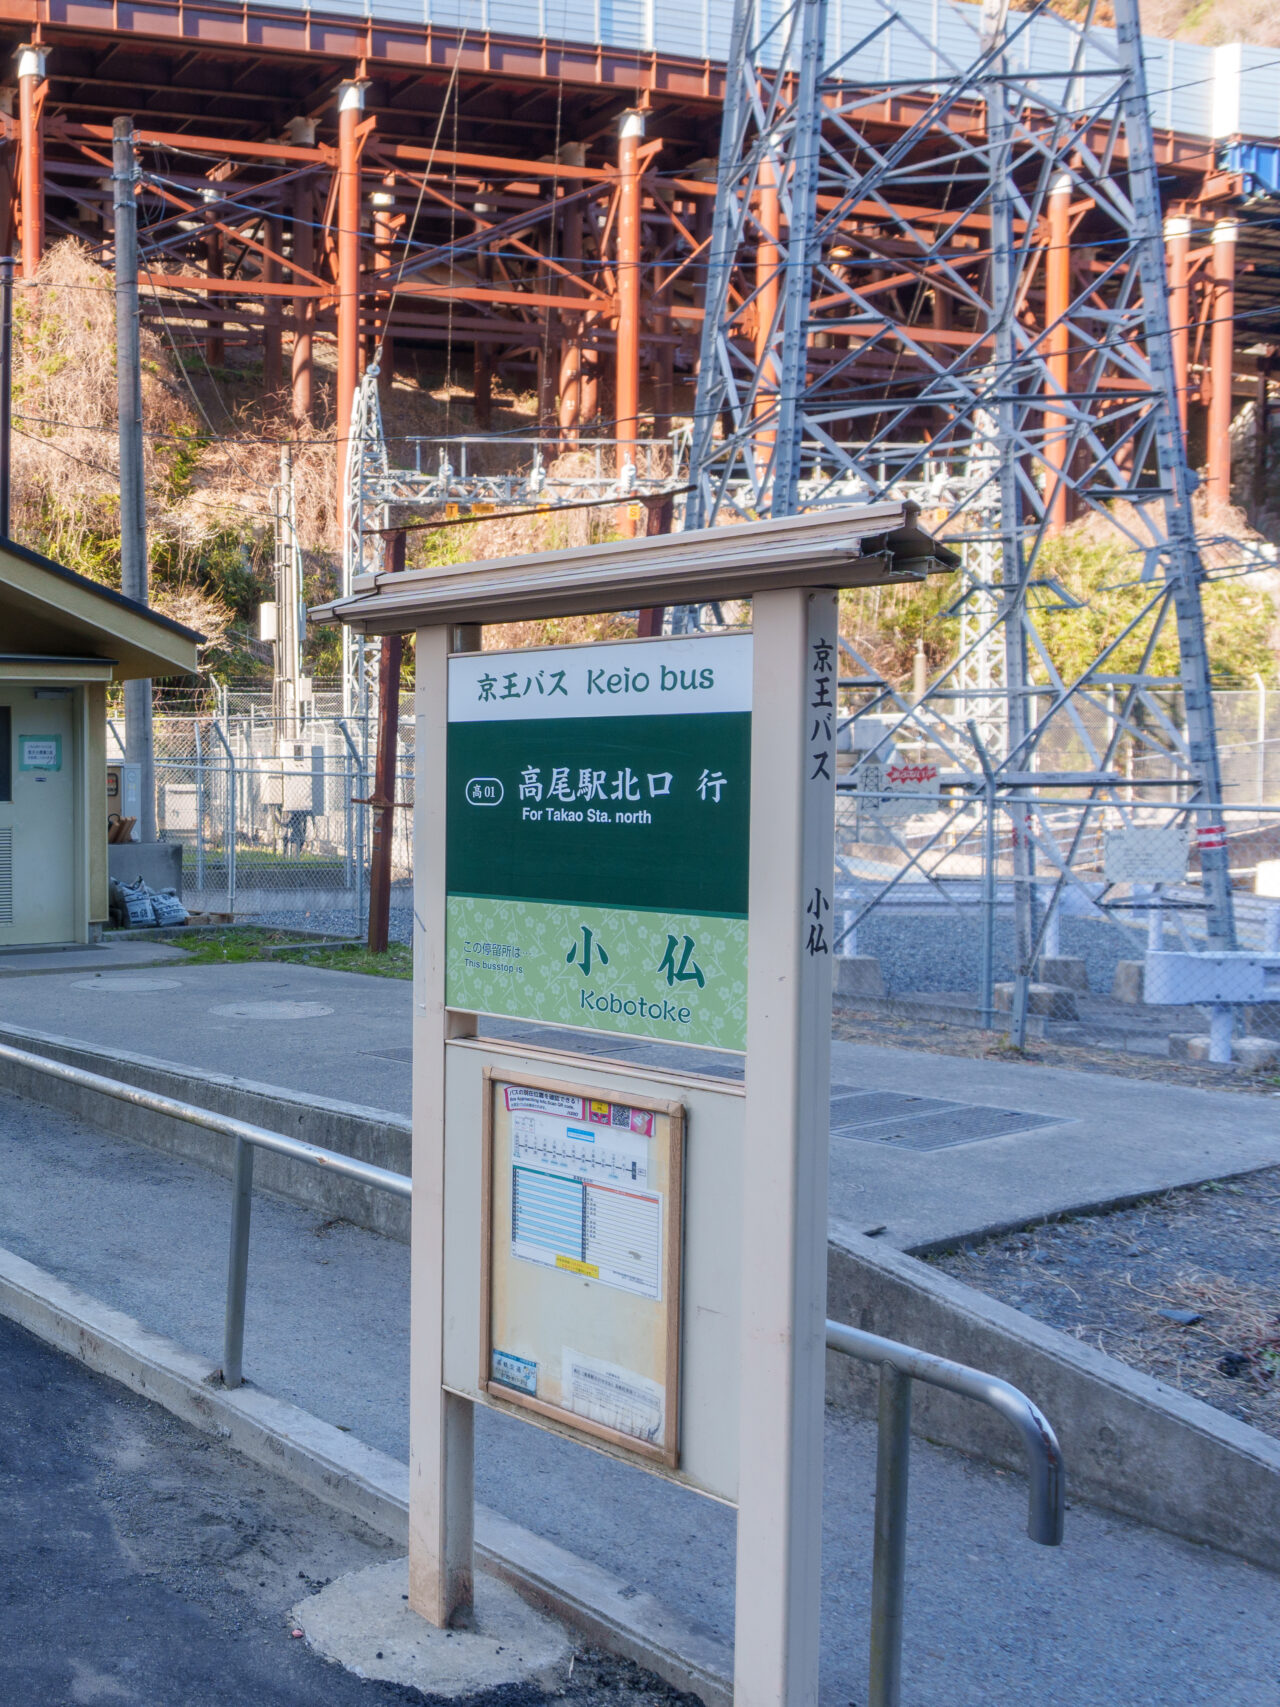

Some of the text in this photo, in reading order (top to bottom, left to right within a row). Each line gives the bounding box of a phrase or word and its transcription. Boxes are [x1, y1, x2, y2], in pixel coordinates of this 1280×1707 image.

[477, 664, 715, 703] 京王バス Keio bus
[810, 637, 835, 782] 京王バス
[518, 765, 729, 804] 高尾駅北口 行
[522, 807, 652, 824] For Takao Sta. north
[806, 888, 829, 957] 小仏
[464, 957, 481, 968] This
[579, 988, 692, 1025] Kobotoke
